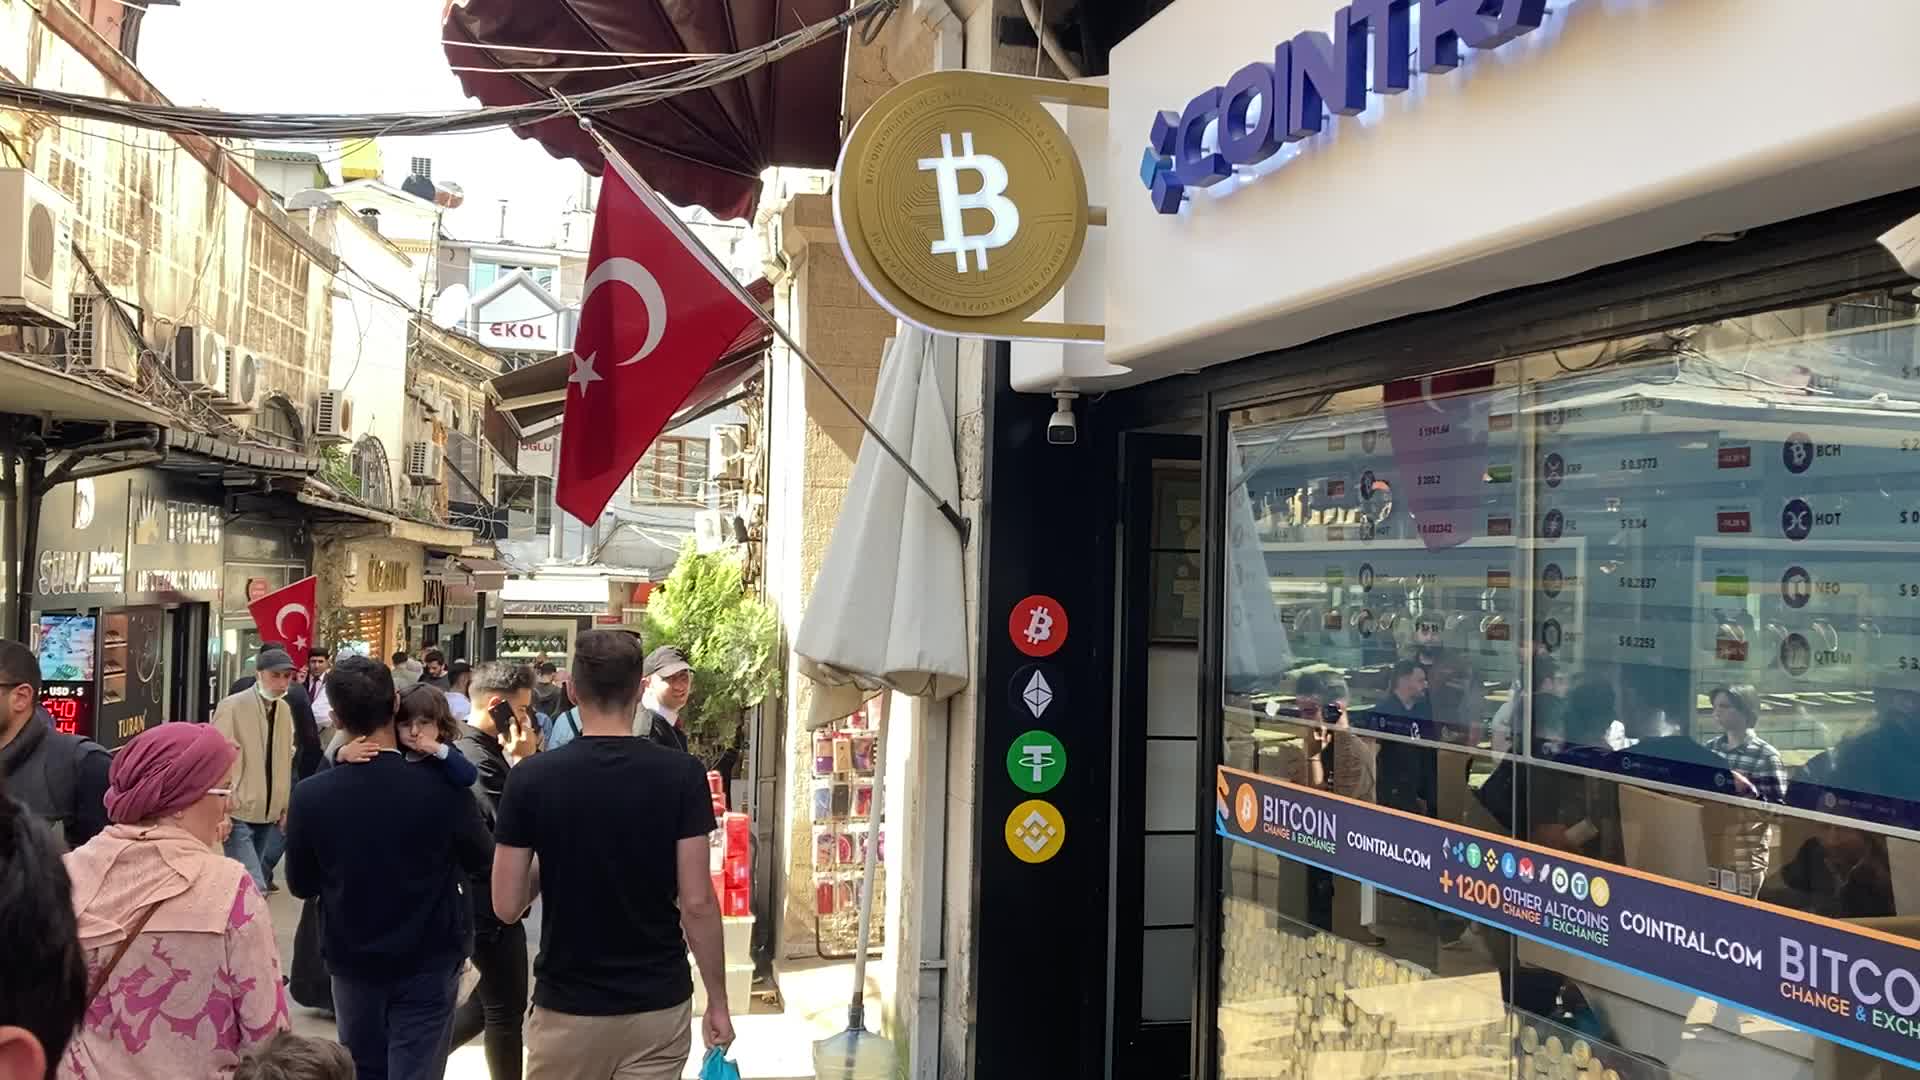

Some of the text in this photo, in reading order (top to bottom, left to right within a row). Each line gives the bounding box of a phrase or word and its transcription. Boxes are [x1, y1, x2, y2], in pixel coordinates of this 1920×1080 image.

[489, 322, 547, 340] EKOL
[1816, 444, 1841, 457] BCH
[1815, 512, 1841, 525] HOT
[49, 686, 69, 697] USD
[1263, 794, 1337, 842] BITCOIN
[1263, 822, 1290, 841] CHANGE
[1297, 833, 1336, 855] EXCHANGE
[1347, 831, 1431, 871] COINTRAL.COM
[1502, 903, 1541, 925] CHANGE
[1552, 918, 1609, 947] EXCHANGE
[1503, 886, 1609, 932] OTHER ALTCOINS
[1620, 910, 1763, 971] COINTRAL.COM
[1780, 936, 1920, 1016] BITCO
[1780, 982, 1850, 1017] CHANGE
[1856, 1006, 1867, 1023] &
